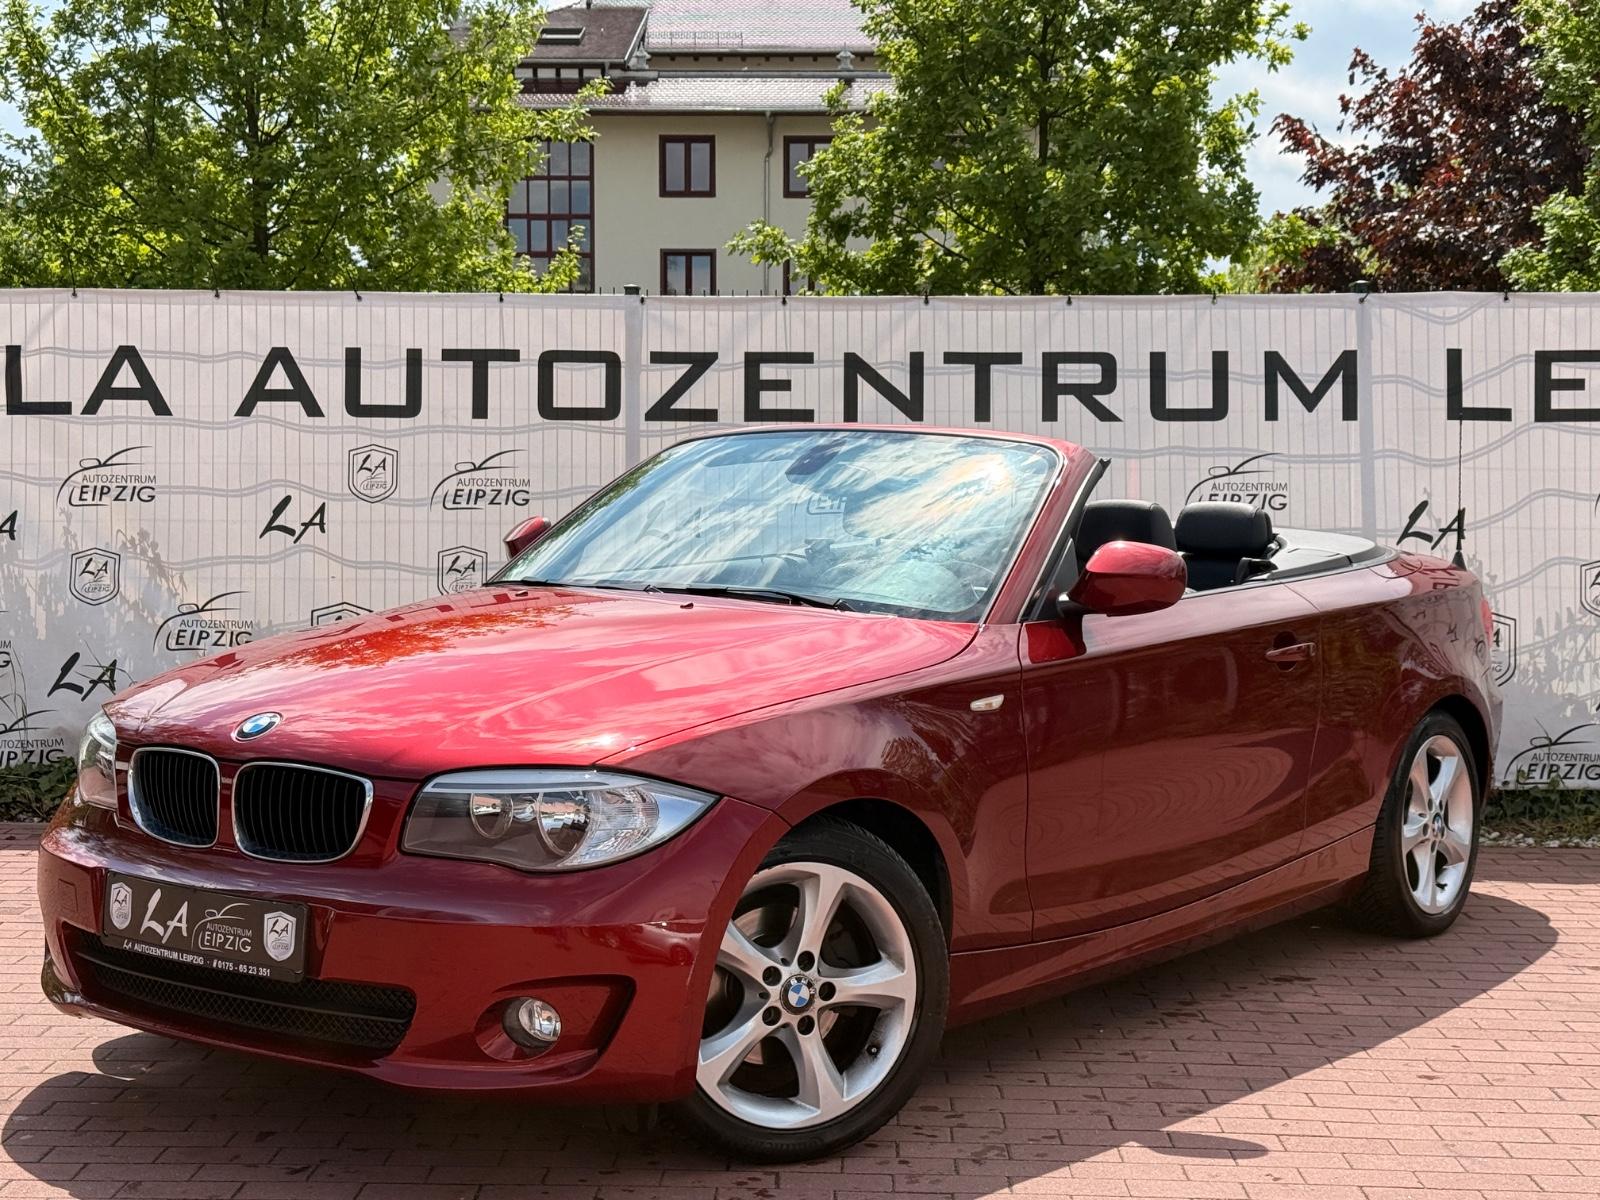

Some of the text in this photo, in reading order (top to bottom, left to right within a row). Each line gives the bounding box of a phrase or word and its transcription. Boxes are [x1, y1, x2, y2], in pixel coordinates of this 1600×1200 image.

[5, 345, 172, 416] LA
[234, 346, 1358, 421] AUTOZENTRUM
[357, 454, 387, 475] LA
[82, 474, 156, 484] AUTOZENTRUM
[457, 478, 530, 488] AUTOZENTRUM
[1211, 482, 1288, 492] AUTOZENTRUM
[259, 495, 326, 544] LA
[1396, 500, 1466, 550] LA
[79, 557, 108, 578] LA
[446, 555, 476, 577] LA
[179, 619, 253, 629] AUTOZENTRUM
[47, 651, 117, 702] LA
[140, 888, 188, 944] LA
[206, 922, 252, 938] AUTOZENTRUM
[269, 919, 289, 937] LA
[133, 943, 178, 960] AUTOZENTRUM
[179, 953, 204, 965] LEIPZIG
